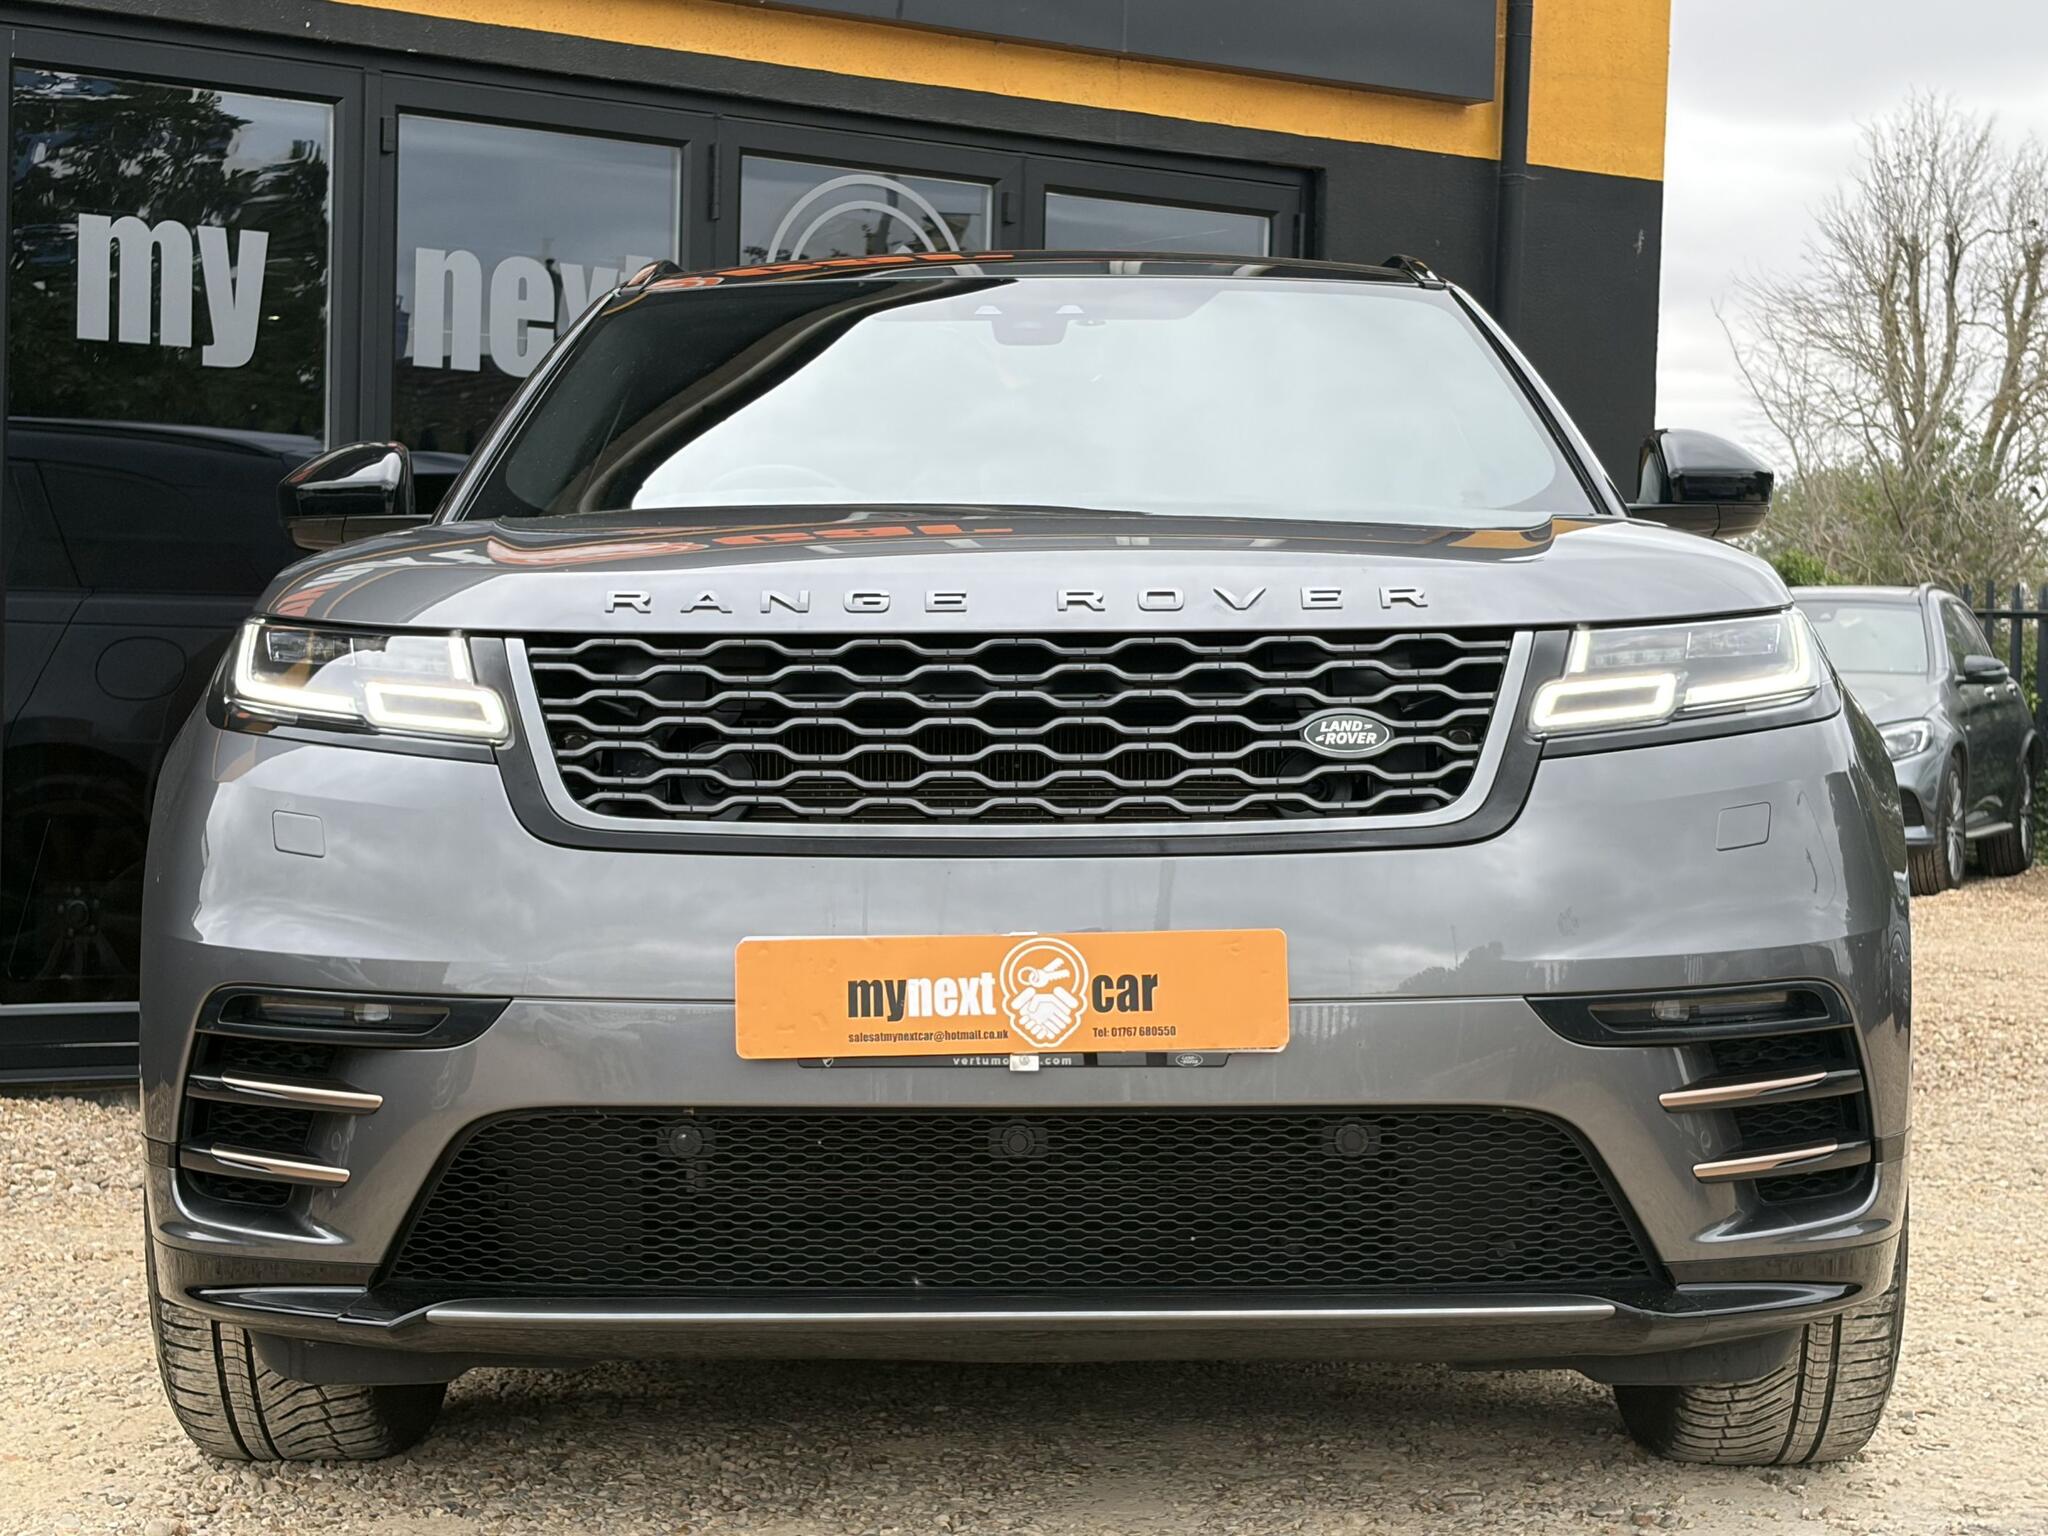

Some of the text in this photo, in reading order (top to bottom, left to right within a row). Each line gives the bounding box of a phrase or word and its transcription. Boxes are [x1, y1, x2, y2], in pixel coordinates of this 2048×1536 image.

[77, 213, 652, 378] my nex
[604, 586, 1429, 613] RANGE ROVER
[1319, 720, 1363, 732] LAND
[1324, 732, 1377, 745] ROVER
[1091, 973, 1158, 1013] car
[1092, 1026, 1177, 1038] Tel: 01767 680550
[952, 1056, 1073, 1066] vertumo.com
